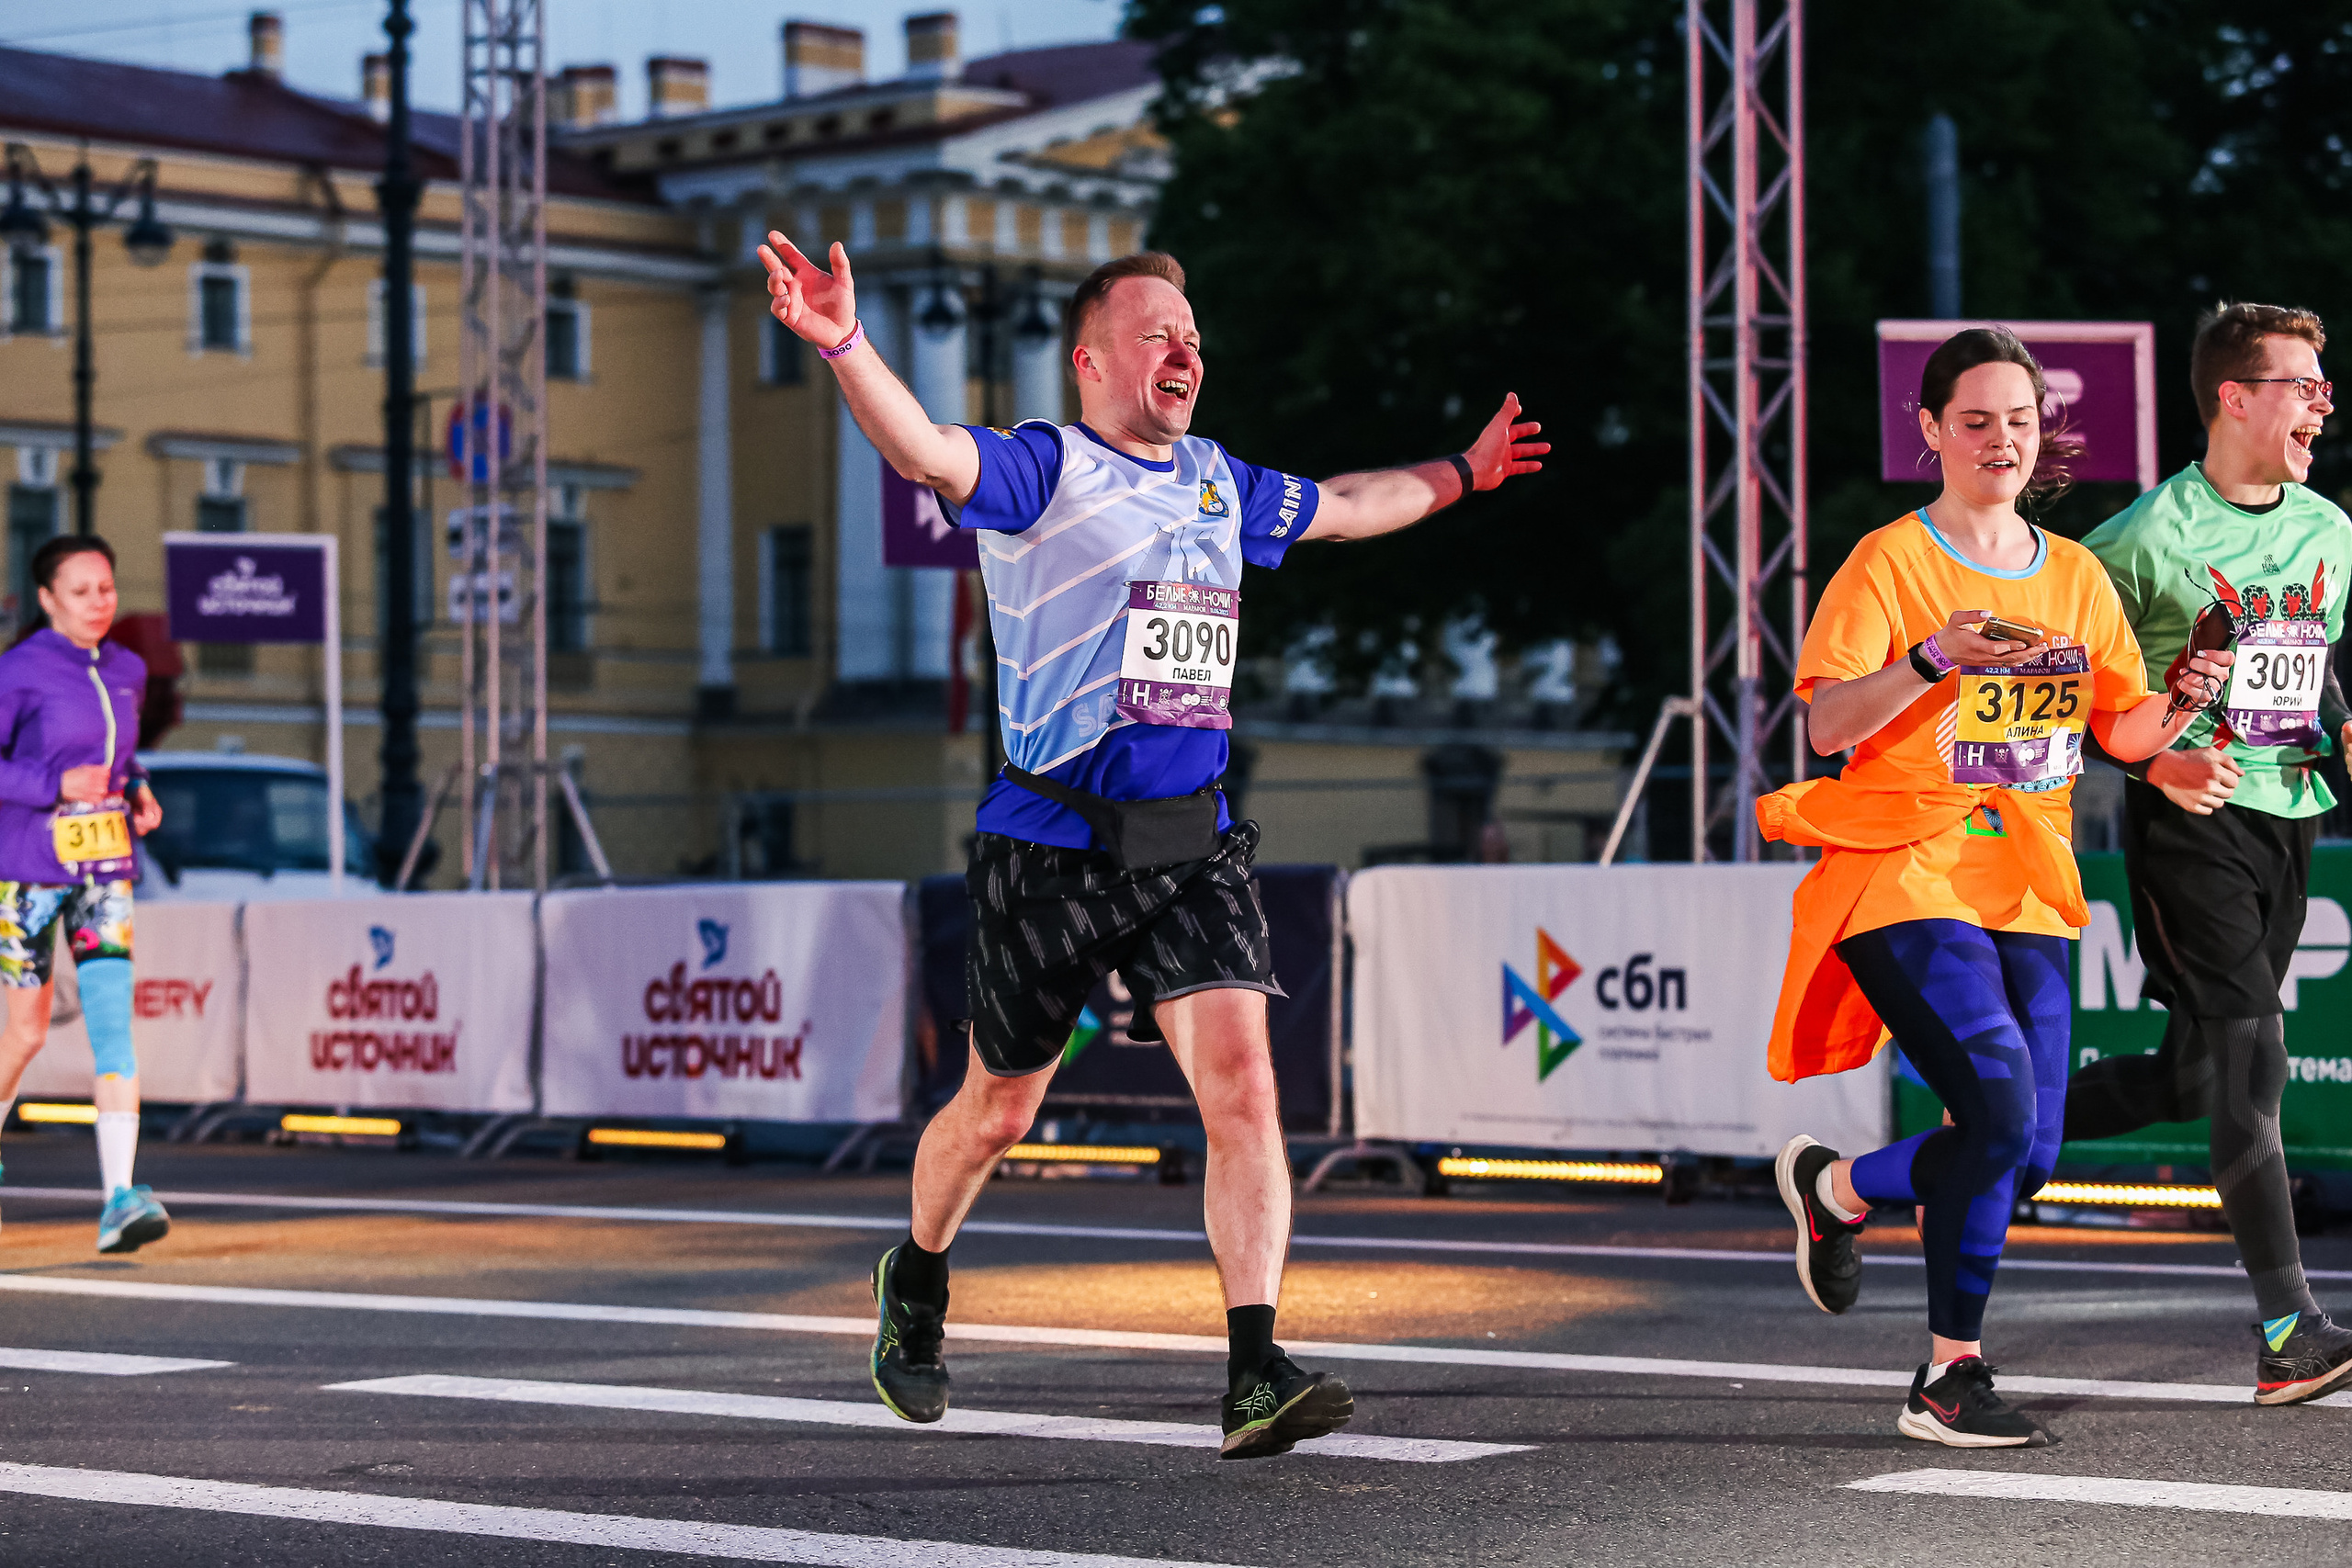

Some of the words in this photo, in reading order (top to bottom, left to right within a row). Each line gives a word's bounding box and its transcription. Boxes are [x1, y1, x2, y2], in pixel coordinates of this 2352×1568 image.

[825, 343, 853, 356] 3090
[1146, 584, 1187, 604] БЕЛЫЕ
[1202, 590, 1232, 609] НОЧИ
[2247, 623, 2286, 638] БЕЛЫЕ
[1143, 617, 1230, 666] 3090
[2048, 649, 2078, 666] НОЧИ
[1172, 668, 1211, 682] ПАВЕЛ
[1984, 667, 1999, 675] 42,2
[2246, 652, 2315, 691] 3091
[1976, 680, 2079, 722] 3125
[2272, 694, 2302, 706] ЮРИЙ
[2006, 725, 2044, 739] АЛИНА
[2078, 897, 2352, 1011] МР
[1596, 953, 1687, 1011] сбп
[134, 979, 213, 1020] ERY
